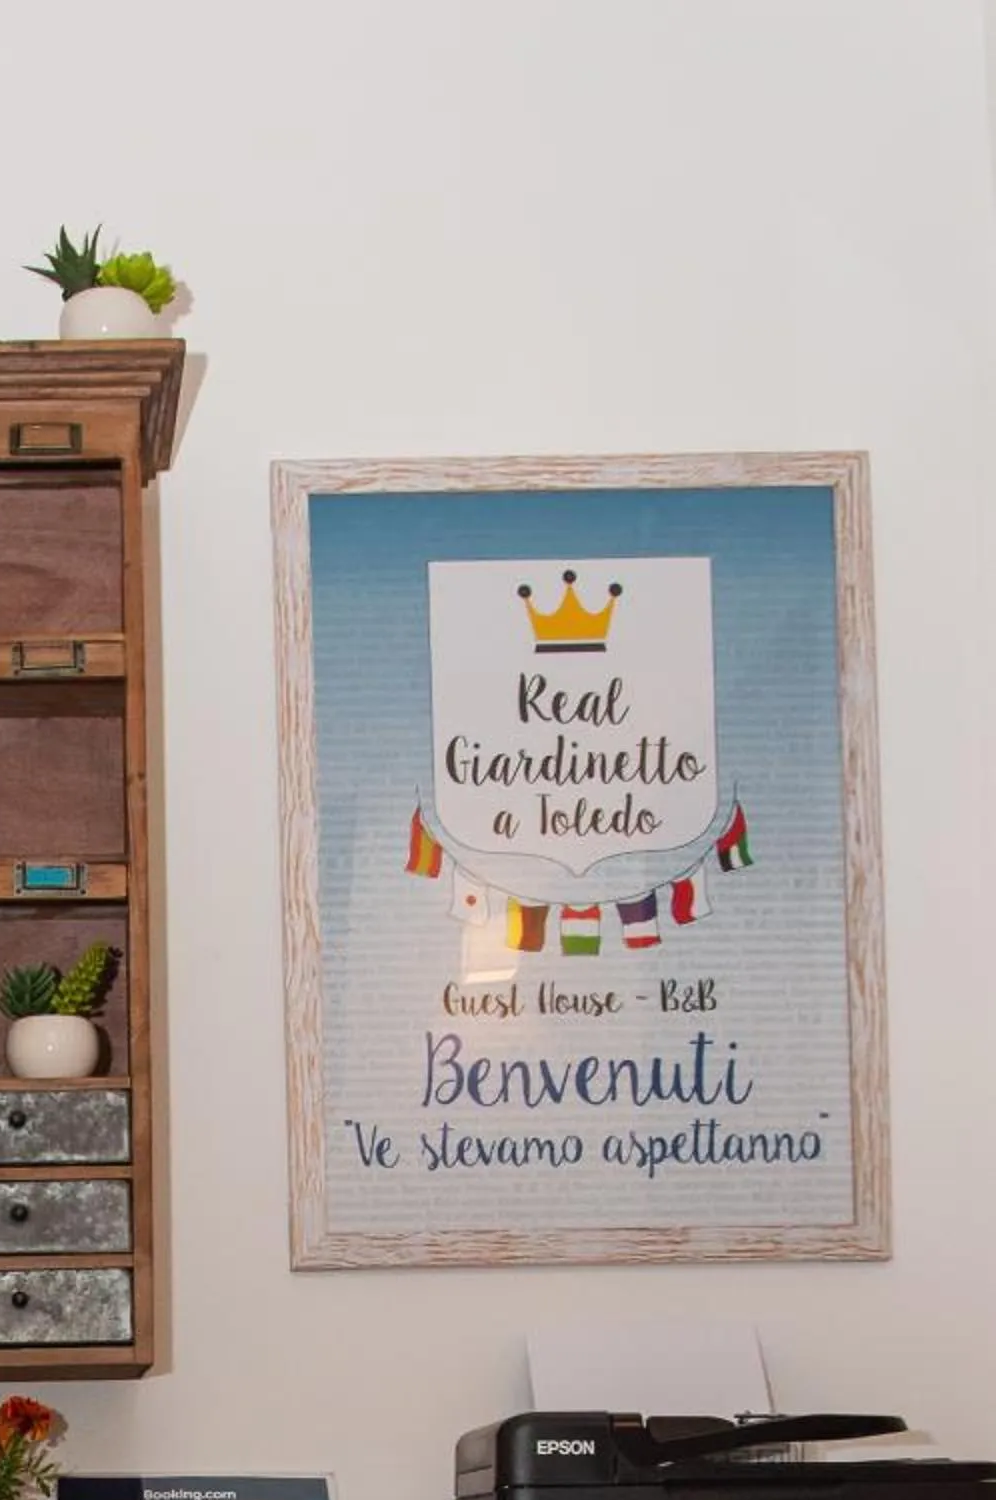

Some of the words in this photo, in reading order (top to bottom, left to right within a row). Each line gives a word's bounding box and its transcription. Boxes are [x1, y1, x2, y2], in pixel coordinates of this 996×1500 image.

[518, 672, 630, 727] Real
[445, 734, 707, 787] Giardinetto
[493, 810, 520, 839] a
[536, 792, 662, 838] Toledo
[443, 981, 525, 1017] Guest
[538, 980, 623, 1016] House
[660, 978, 717, 1013] B&B
[421, 1031, 753, 1108] Benvenuti
[421, 1121, 584, 1171] stevamo
[537, 1439, 595, 1455] EPSON
[143, 1488, 237, 1500] Booking.com
